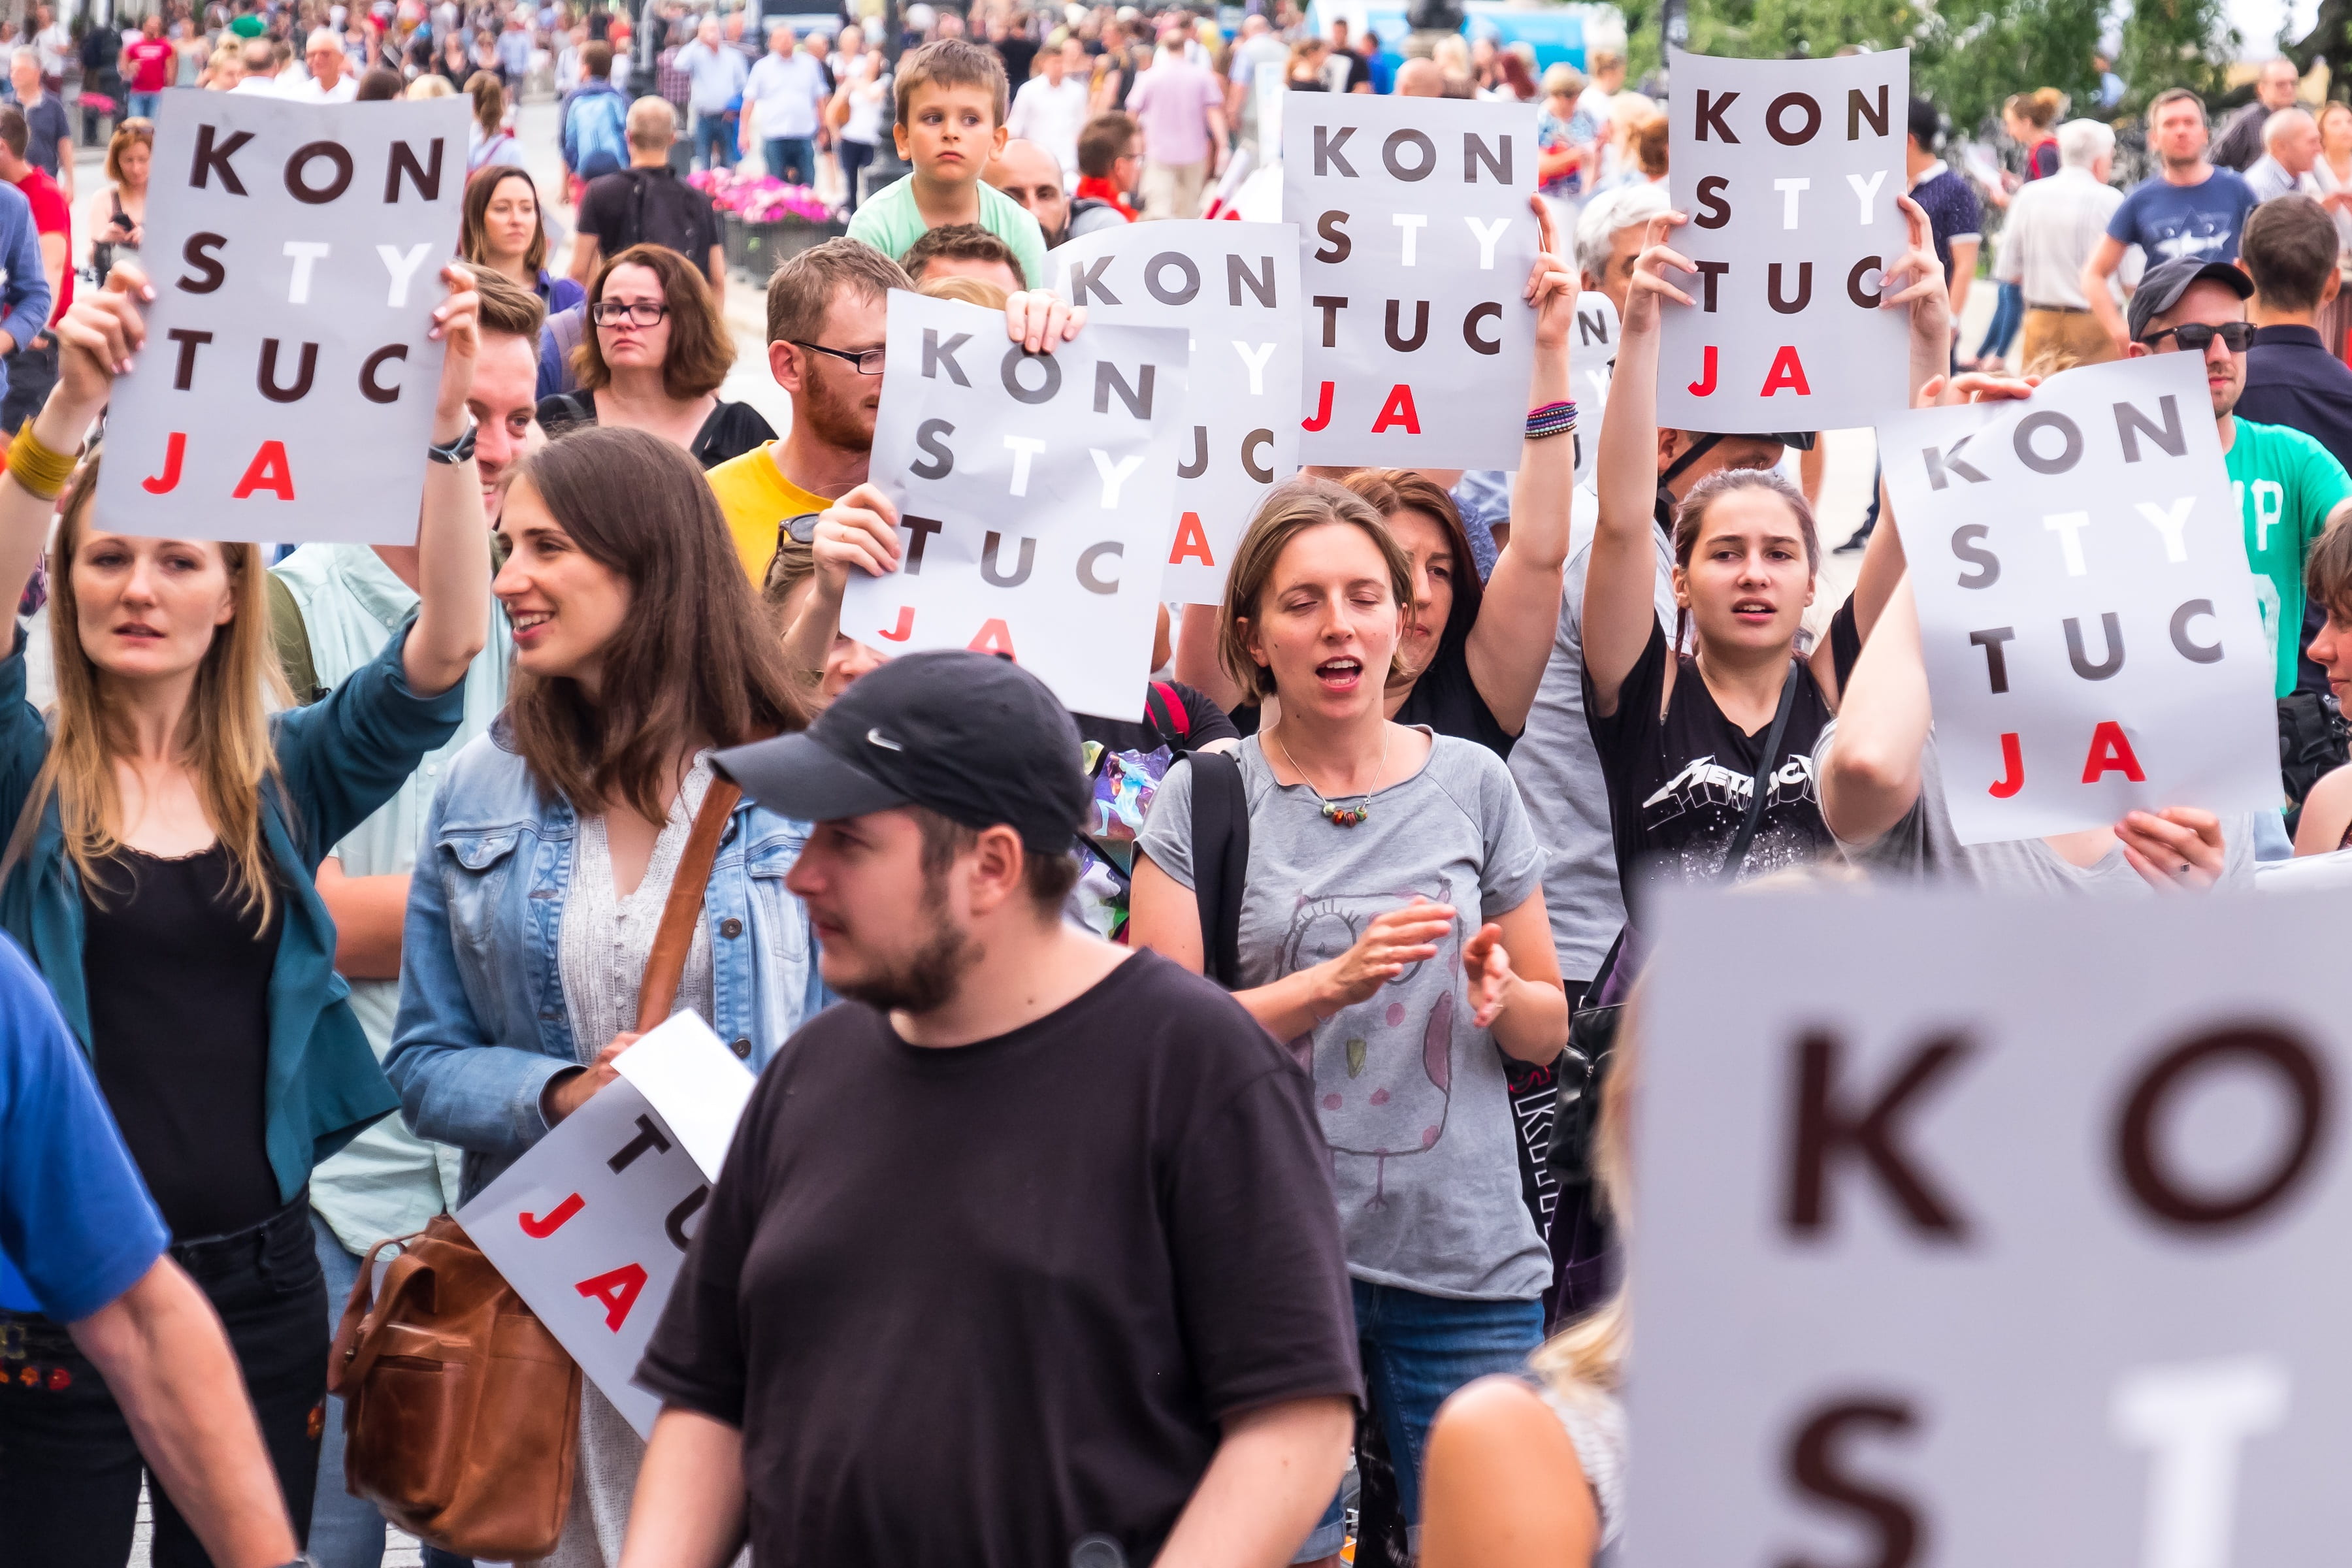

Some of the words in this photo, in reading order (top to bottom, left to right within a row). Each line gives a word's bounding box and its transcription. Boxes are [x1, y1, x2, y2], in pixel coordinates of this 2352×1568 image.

[1695, 84, 1889, 146] KON
[188, 123, 444, 205] KON
[1313, 125, 1513, 185] KON
[1693, 170, 1889, 230] STY
[175, 231, 434, 308] STY
[1314, 209, 1513, 270] STY
[1070, 251, 1277, 308] KON
[1694, 255, 1882, 314] TUC
[1313, 295, 1503, 355] TUC
[168, 327, 409, 403] TUC
[921, 327, 1156, 420] KON
[1687, 345, 1811, 397] JA
[1301, 381, 1422, 434] JA
[1921, 394, 2189, 491] KON
[140, 431, 295, 500] JA
[908, 417, 1146, 510] STY
[900, 514, 1125, 595] TUC
[1169, 512, 1215, 567] A
[1950, 496, 2198, 589] STY
[877, 606, 1017, 662] JA
[1969, 598, 2225, 694] TUC
[1988, 721, 2148, 799] JA
[1778, 1014, 2338, 1245] KO
[607, 1113, 713, 1254] TU
[519, 1192, 649, 1334] JA
[1762, 1356, 2289, 1568] ST
